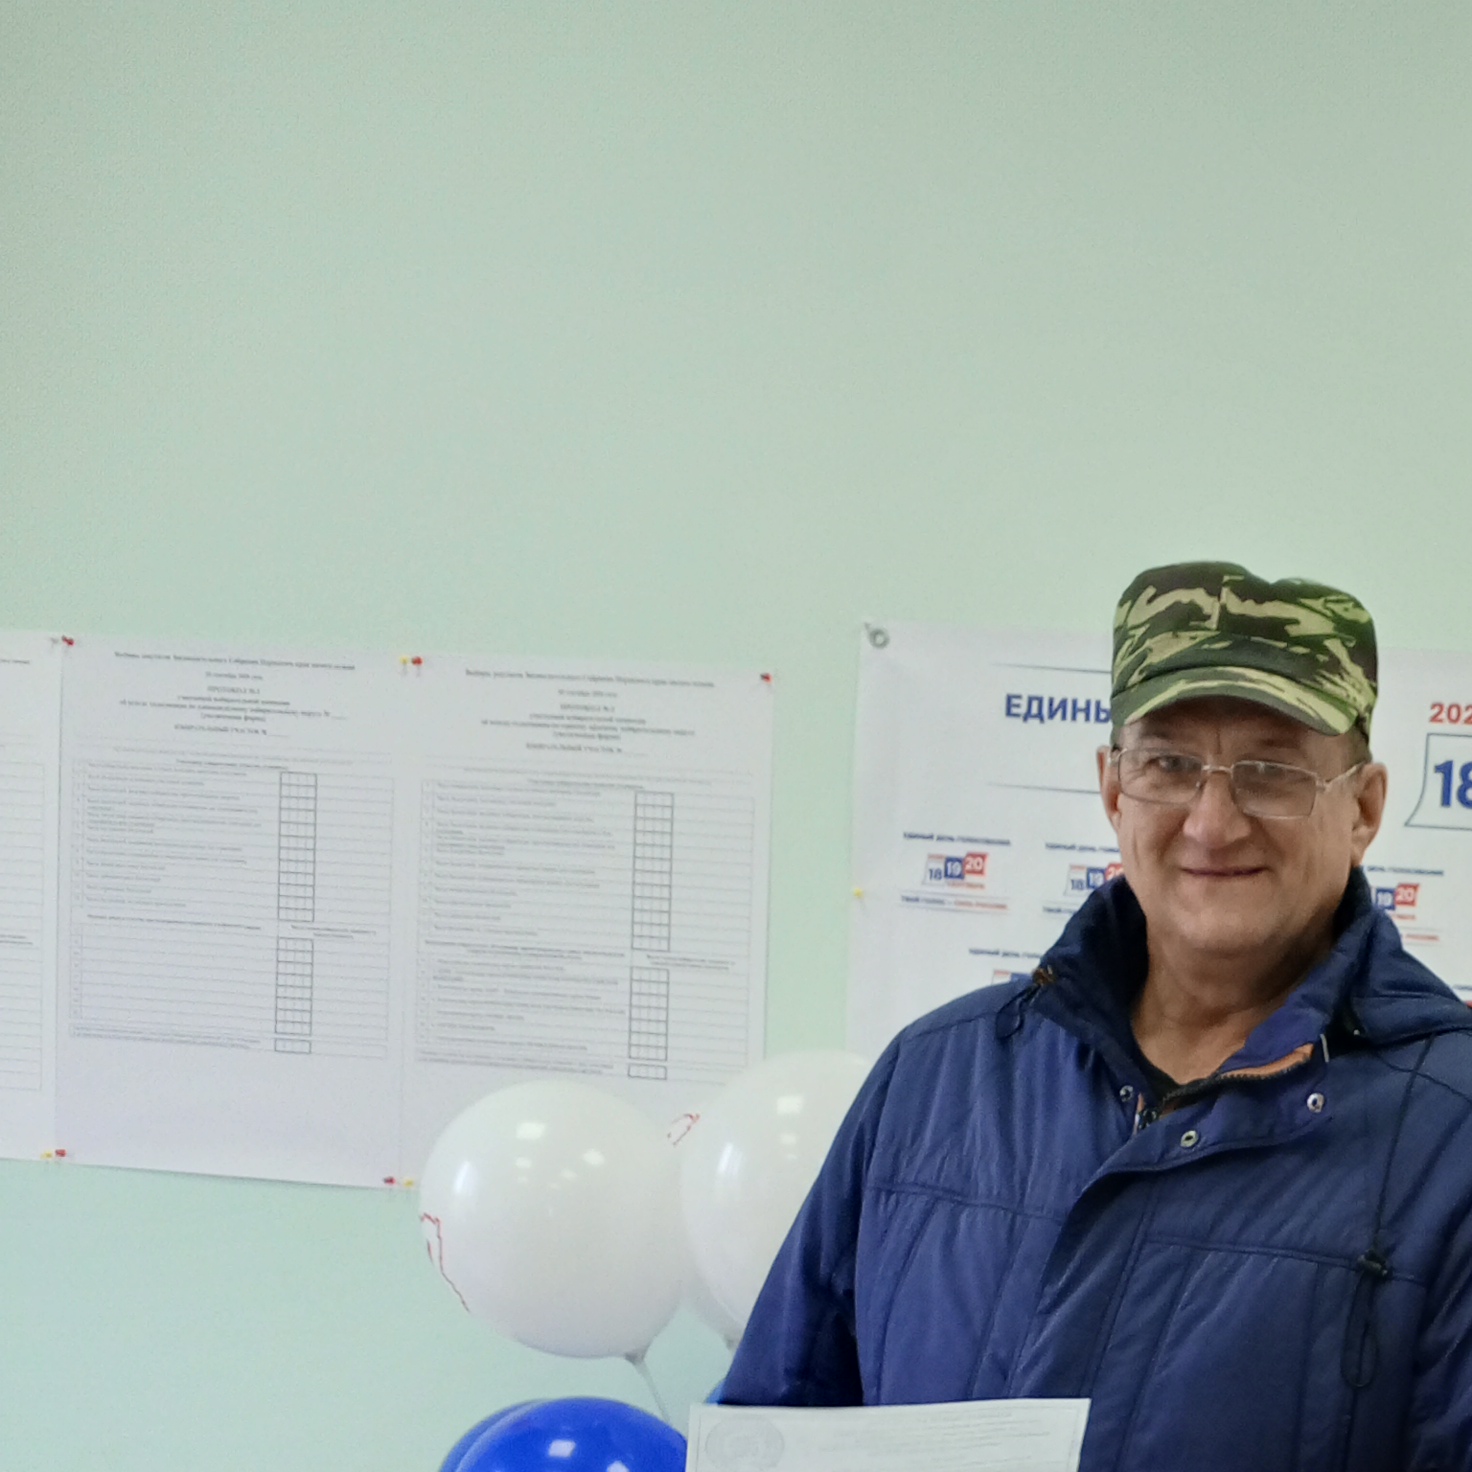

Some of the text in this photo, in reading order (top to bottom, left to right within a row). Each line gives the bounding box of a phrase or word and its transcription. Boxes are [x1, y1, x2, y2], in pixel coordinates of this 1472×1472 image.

[1005, 693, 1111, 723] ЕДИНЫ
[929, 856, 984, 881] 18 19 20
[1396, 887, 1415, 903] 20
